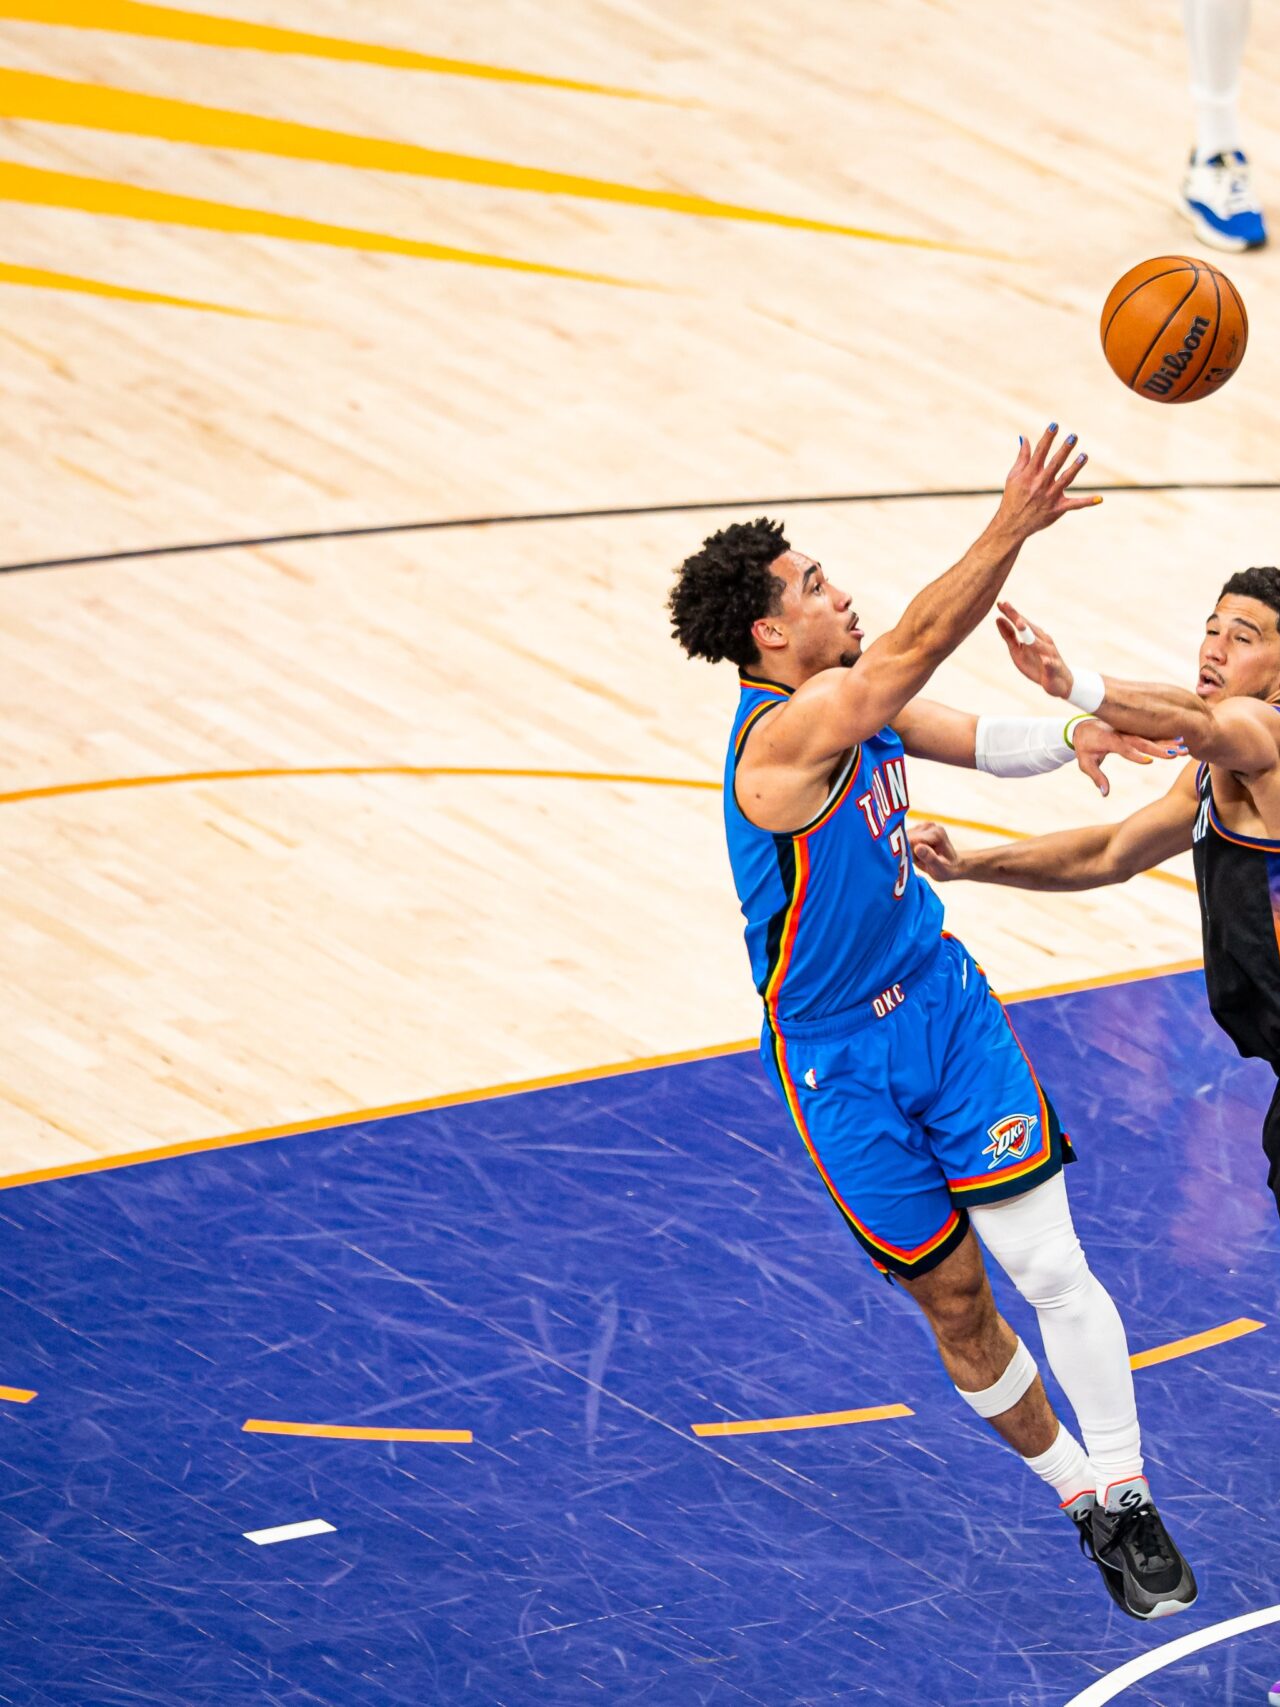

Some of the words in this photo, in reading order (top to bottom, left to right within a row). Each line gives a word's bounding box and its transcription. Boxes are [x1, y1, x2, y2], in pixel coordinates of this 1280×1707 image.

[1142, 315, 1210, 395] Wilson
[872, 982, 906, 1019] OKC
[997, 1120, 1025, 1157] OKC
